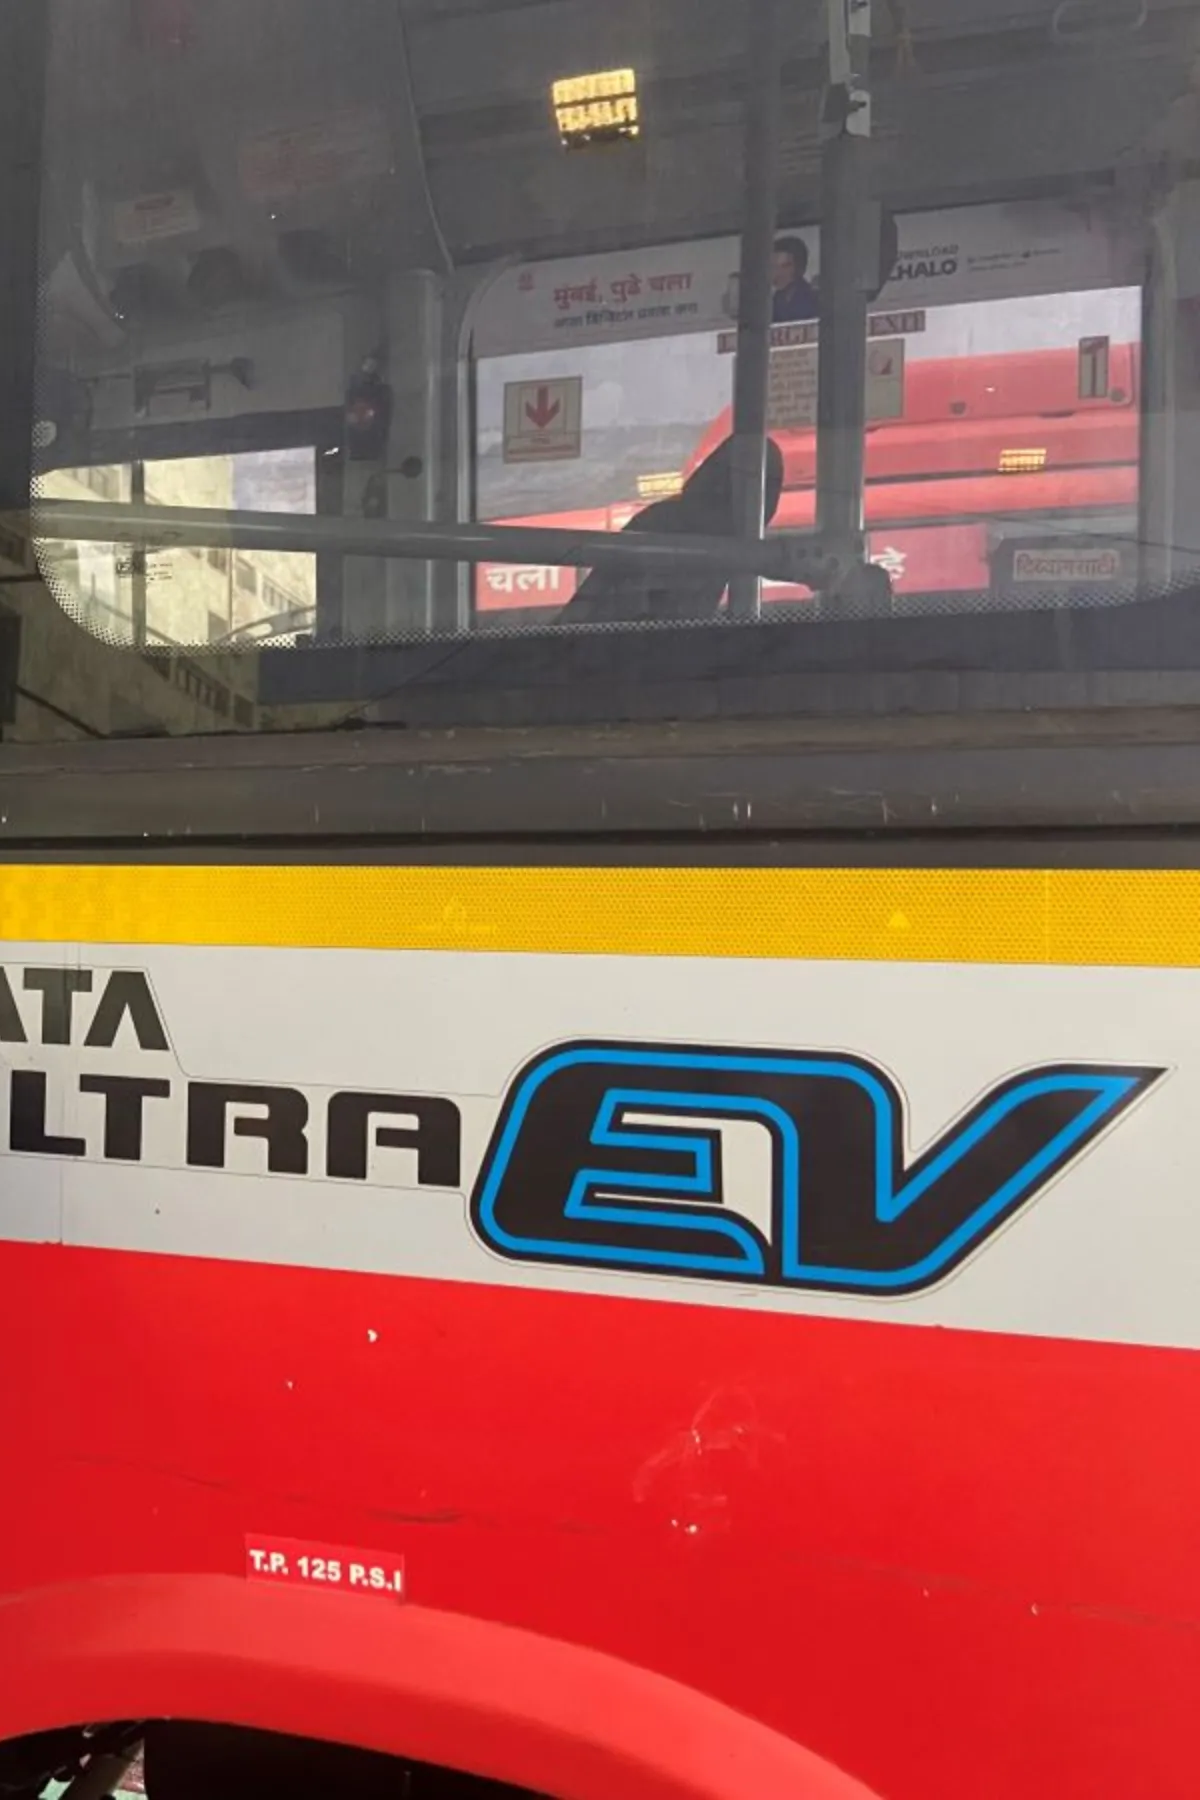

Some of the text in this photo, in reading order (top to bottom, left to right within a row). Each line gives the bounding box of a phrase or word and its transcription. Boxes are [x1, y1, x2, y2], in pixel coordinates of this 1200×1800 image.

[648, 272, 693, 292] चला
[870, 311, 925, 336] EXIT
[486, 566, 559, 593] चला
[471, 1039, 1167, 1297] EV
[249, 1549, 289, 1575] T.P.
[297, 1556, 342, 1582] 125
